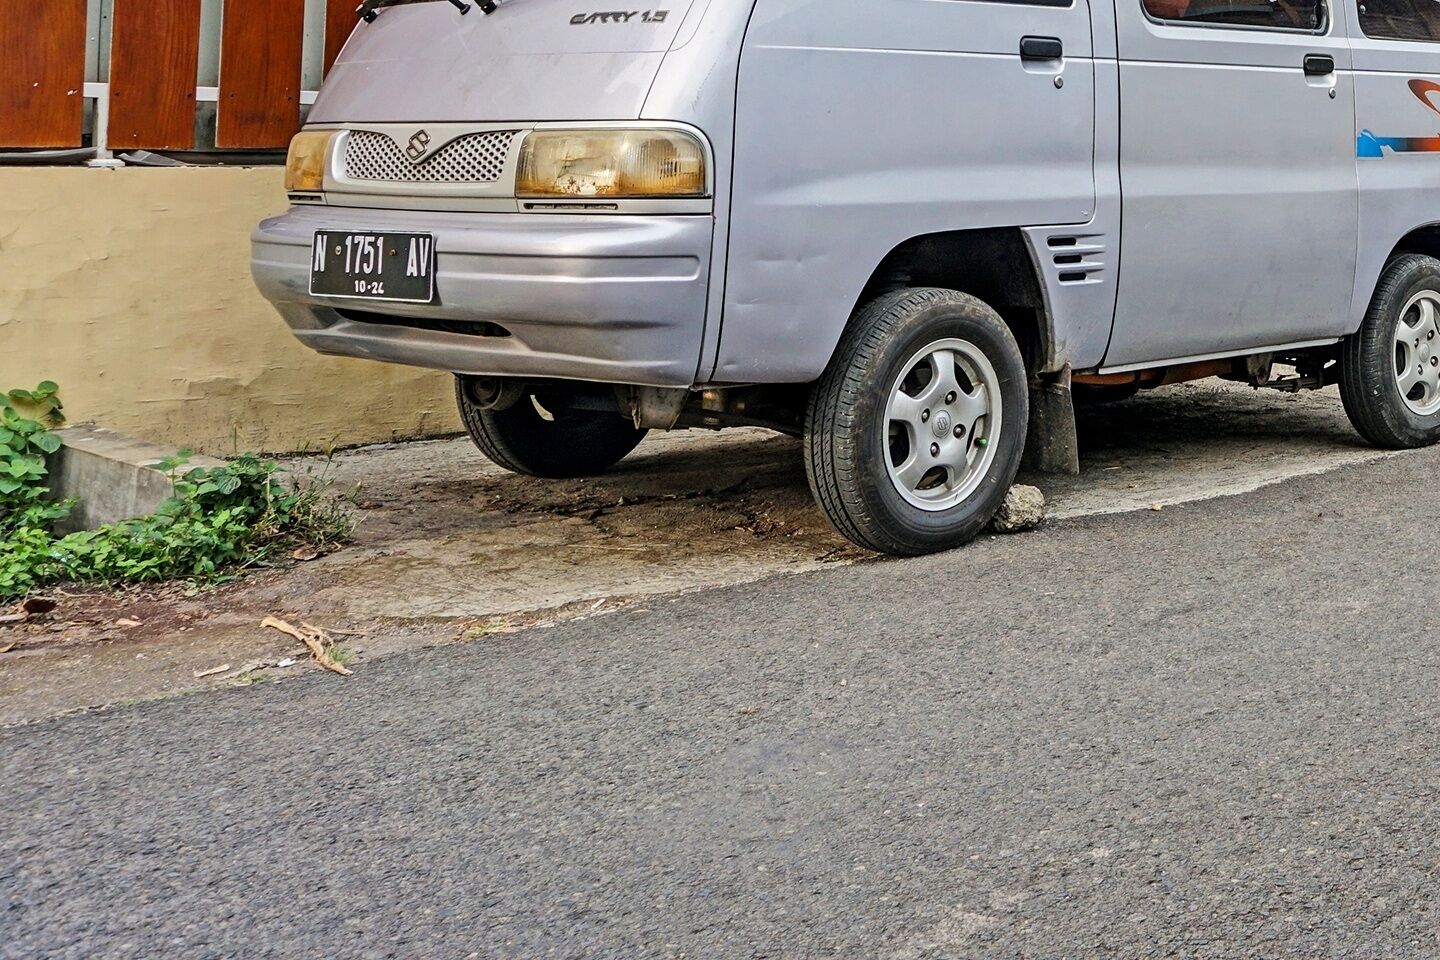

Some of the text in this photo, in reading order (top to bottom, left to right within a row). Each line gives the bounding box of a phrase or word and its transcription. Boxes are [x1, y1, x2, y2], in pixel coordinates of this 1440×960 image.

[569, 9, 670, 25] CARRY 1.5
[313, 234, 431, 277] N 1751 AV
